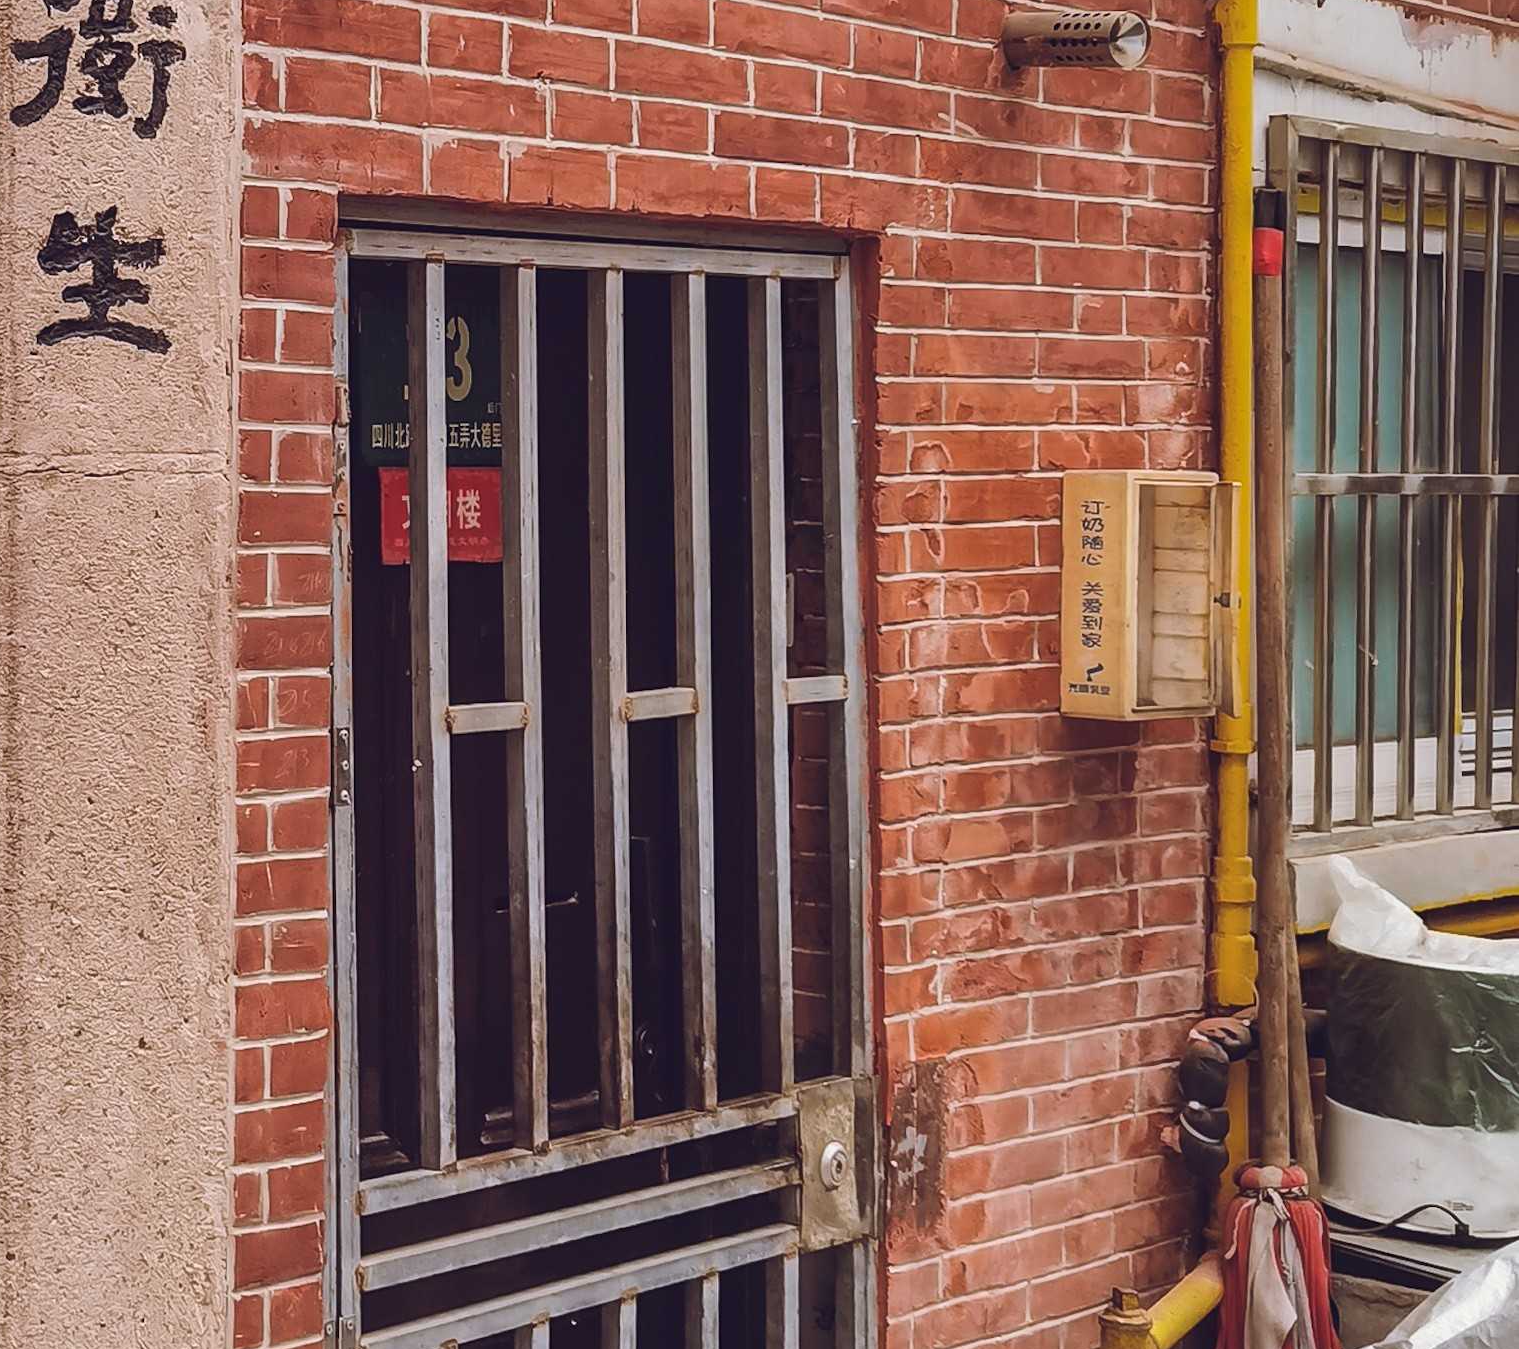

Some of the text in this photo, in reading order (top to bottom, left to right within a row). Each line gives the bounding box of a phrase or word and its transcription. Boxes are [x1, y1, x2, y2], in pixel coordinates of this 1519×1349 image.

[1081, 500, 1105, 648] 订奶随心 关爱到家
